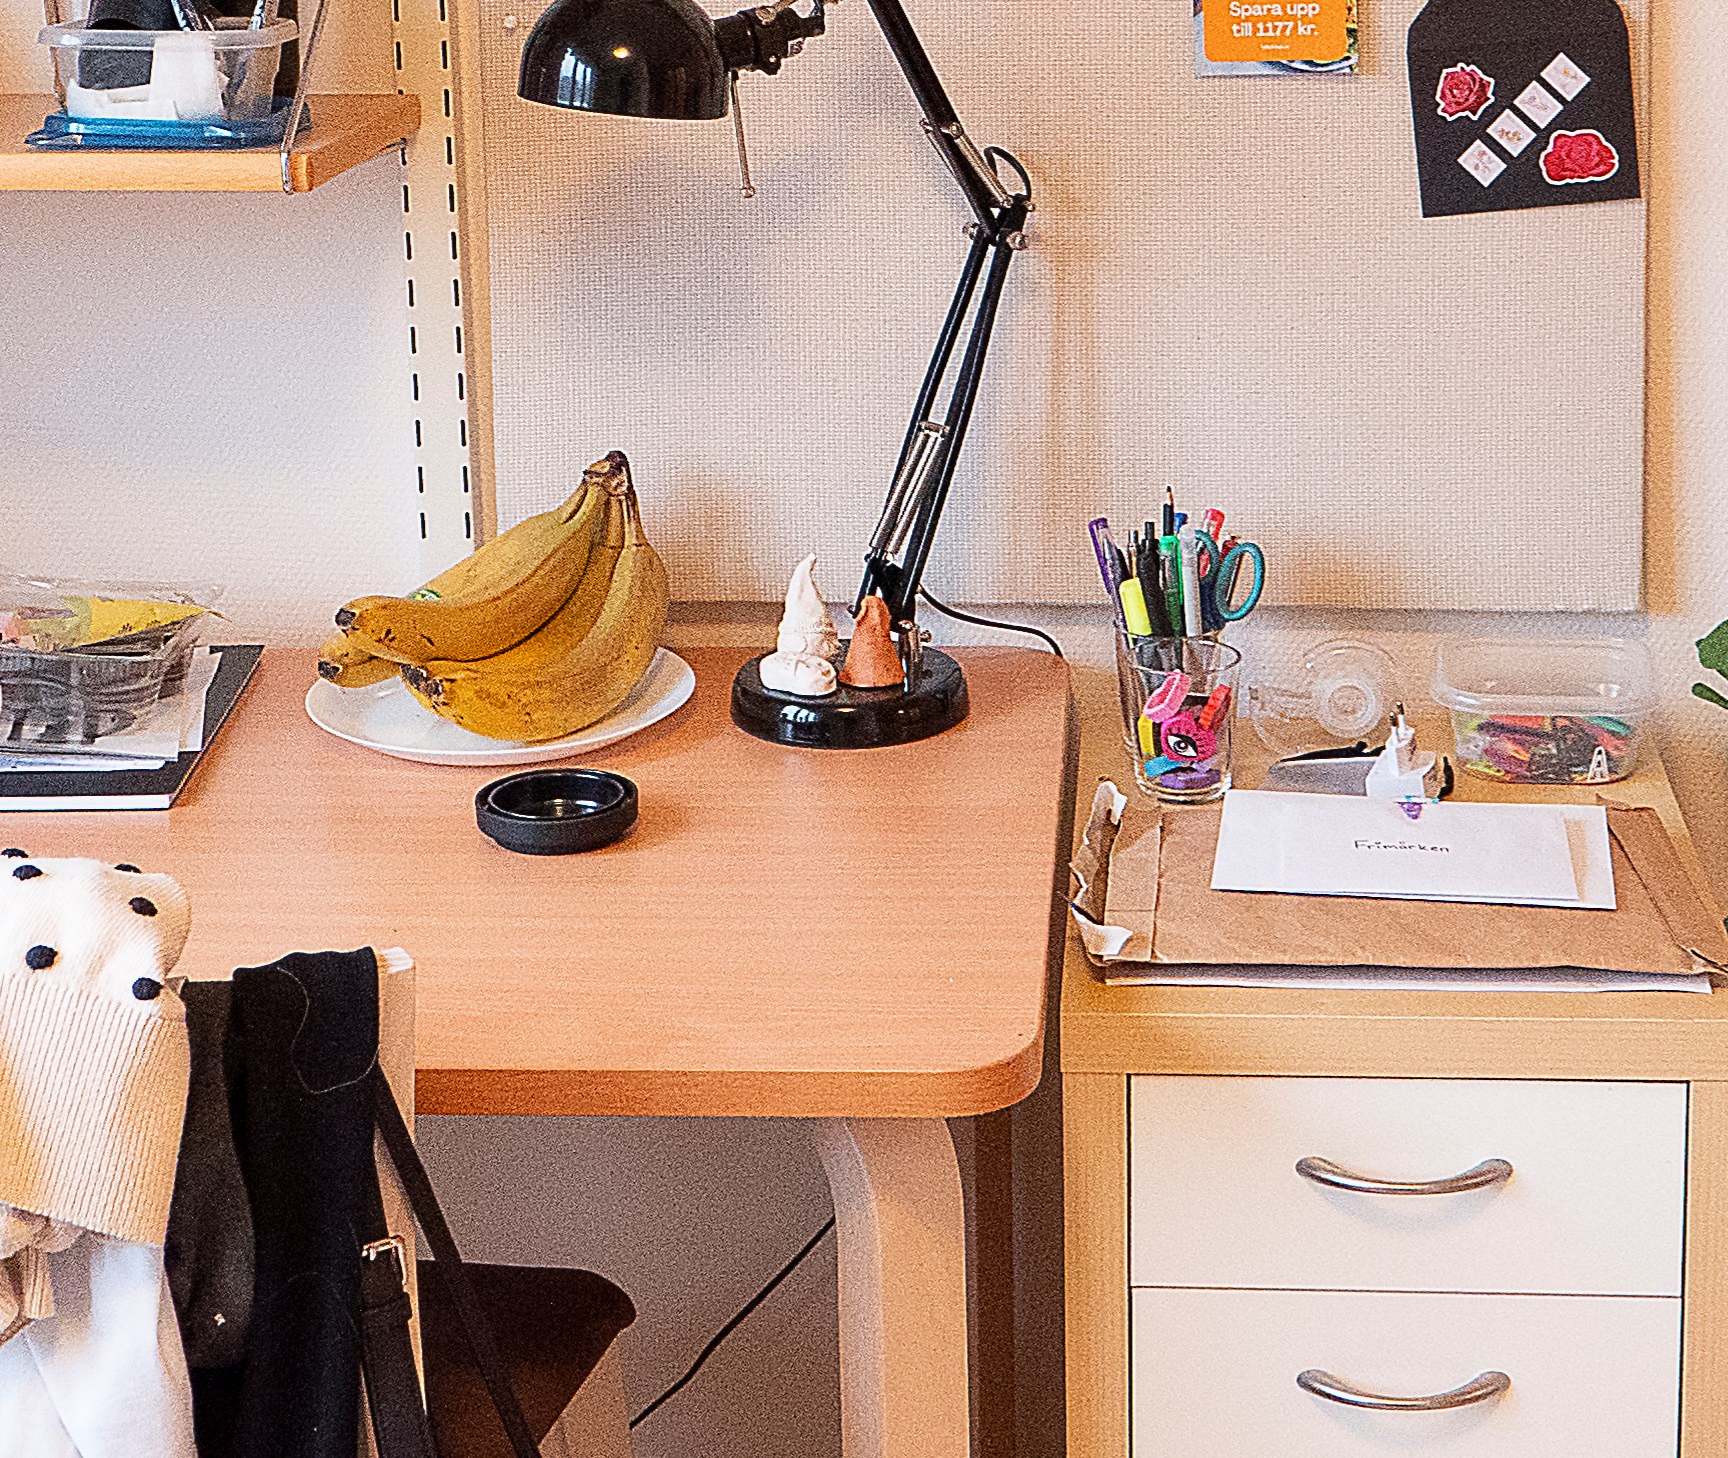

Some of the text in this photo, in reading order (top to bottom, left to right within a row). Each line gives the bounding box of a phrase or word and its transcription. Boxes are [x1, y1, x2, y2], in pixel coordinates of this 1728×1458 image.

[1229, 1, 1320, 19] Spara upp
[1232, 21, 1319, 37] till 1177 kr.
[1354, 839, 1450, 853] Frimärken
